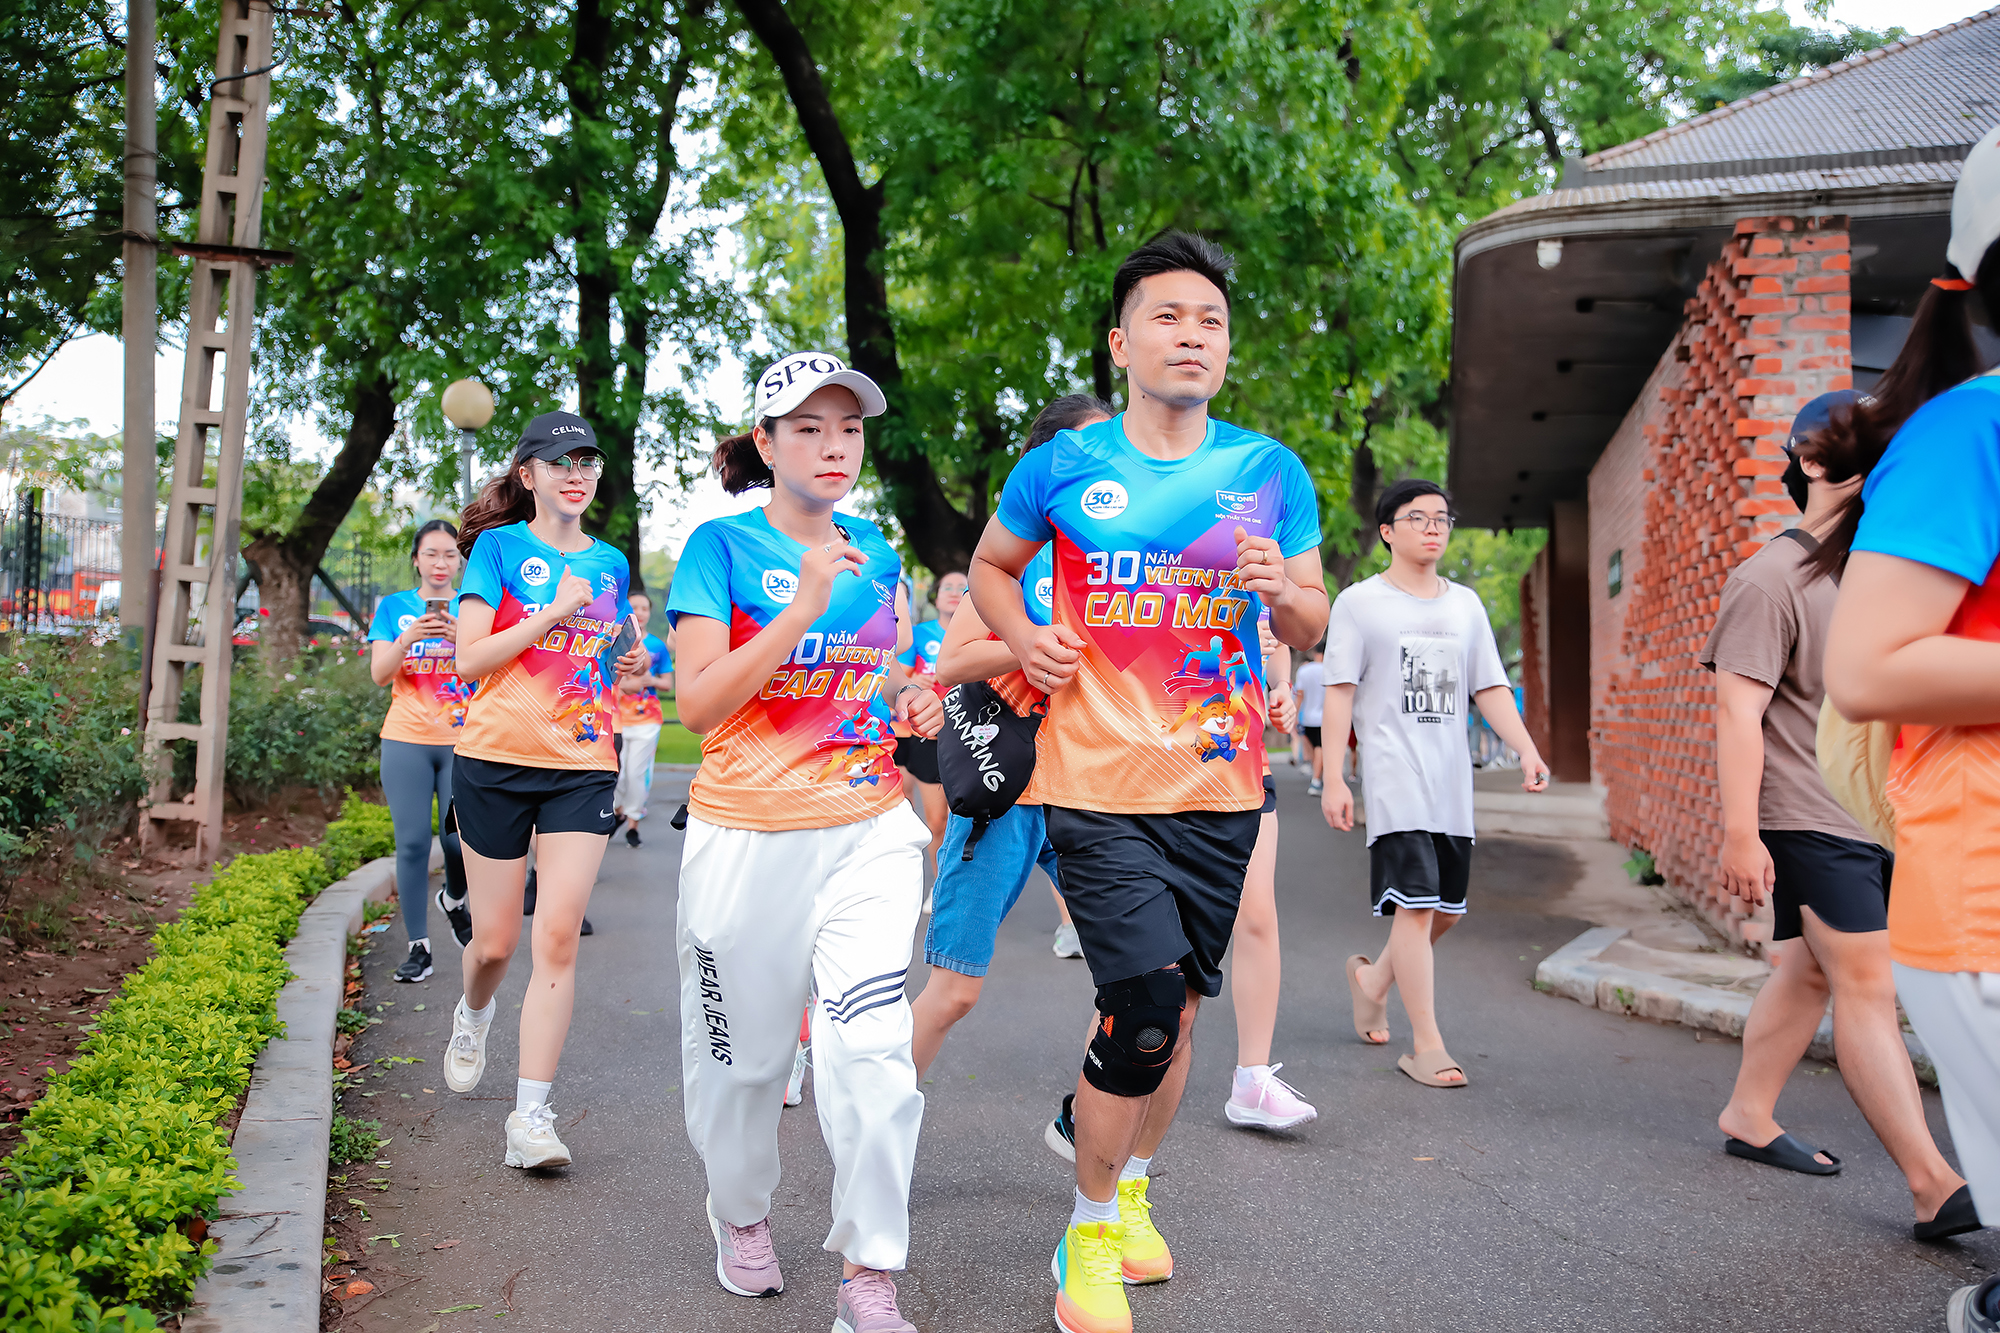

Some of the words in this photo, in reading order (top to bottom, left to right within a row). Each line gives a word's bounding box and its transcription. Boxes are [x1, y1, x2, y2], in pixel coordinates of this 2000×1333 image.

[1219, 494, 1236, 502] THE
[1086, 551, 1141, 585] 30
[1145, 550, 1183, 565] NĂM
[1085, 592, 1166, 627] CAO
[826, 630, 859, 645] NĂM
[759, 669, 835, 700] CAO
[1404, 690, 1455, 714] TOWN
[693, 944, 724, 1003] WEAR
[702, 1002, 733, 1067] JEANS
